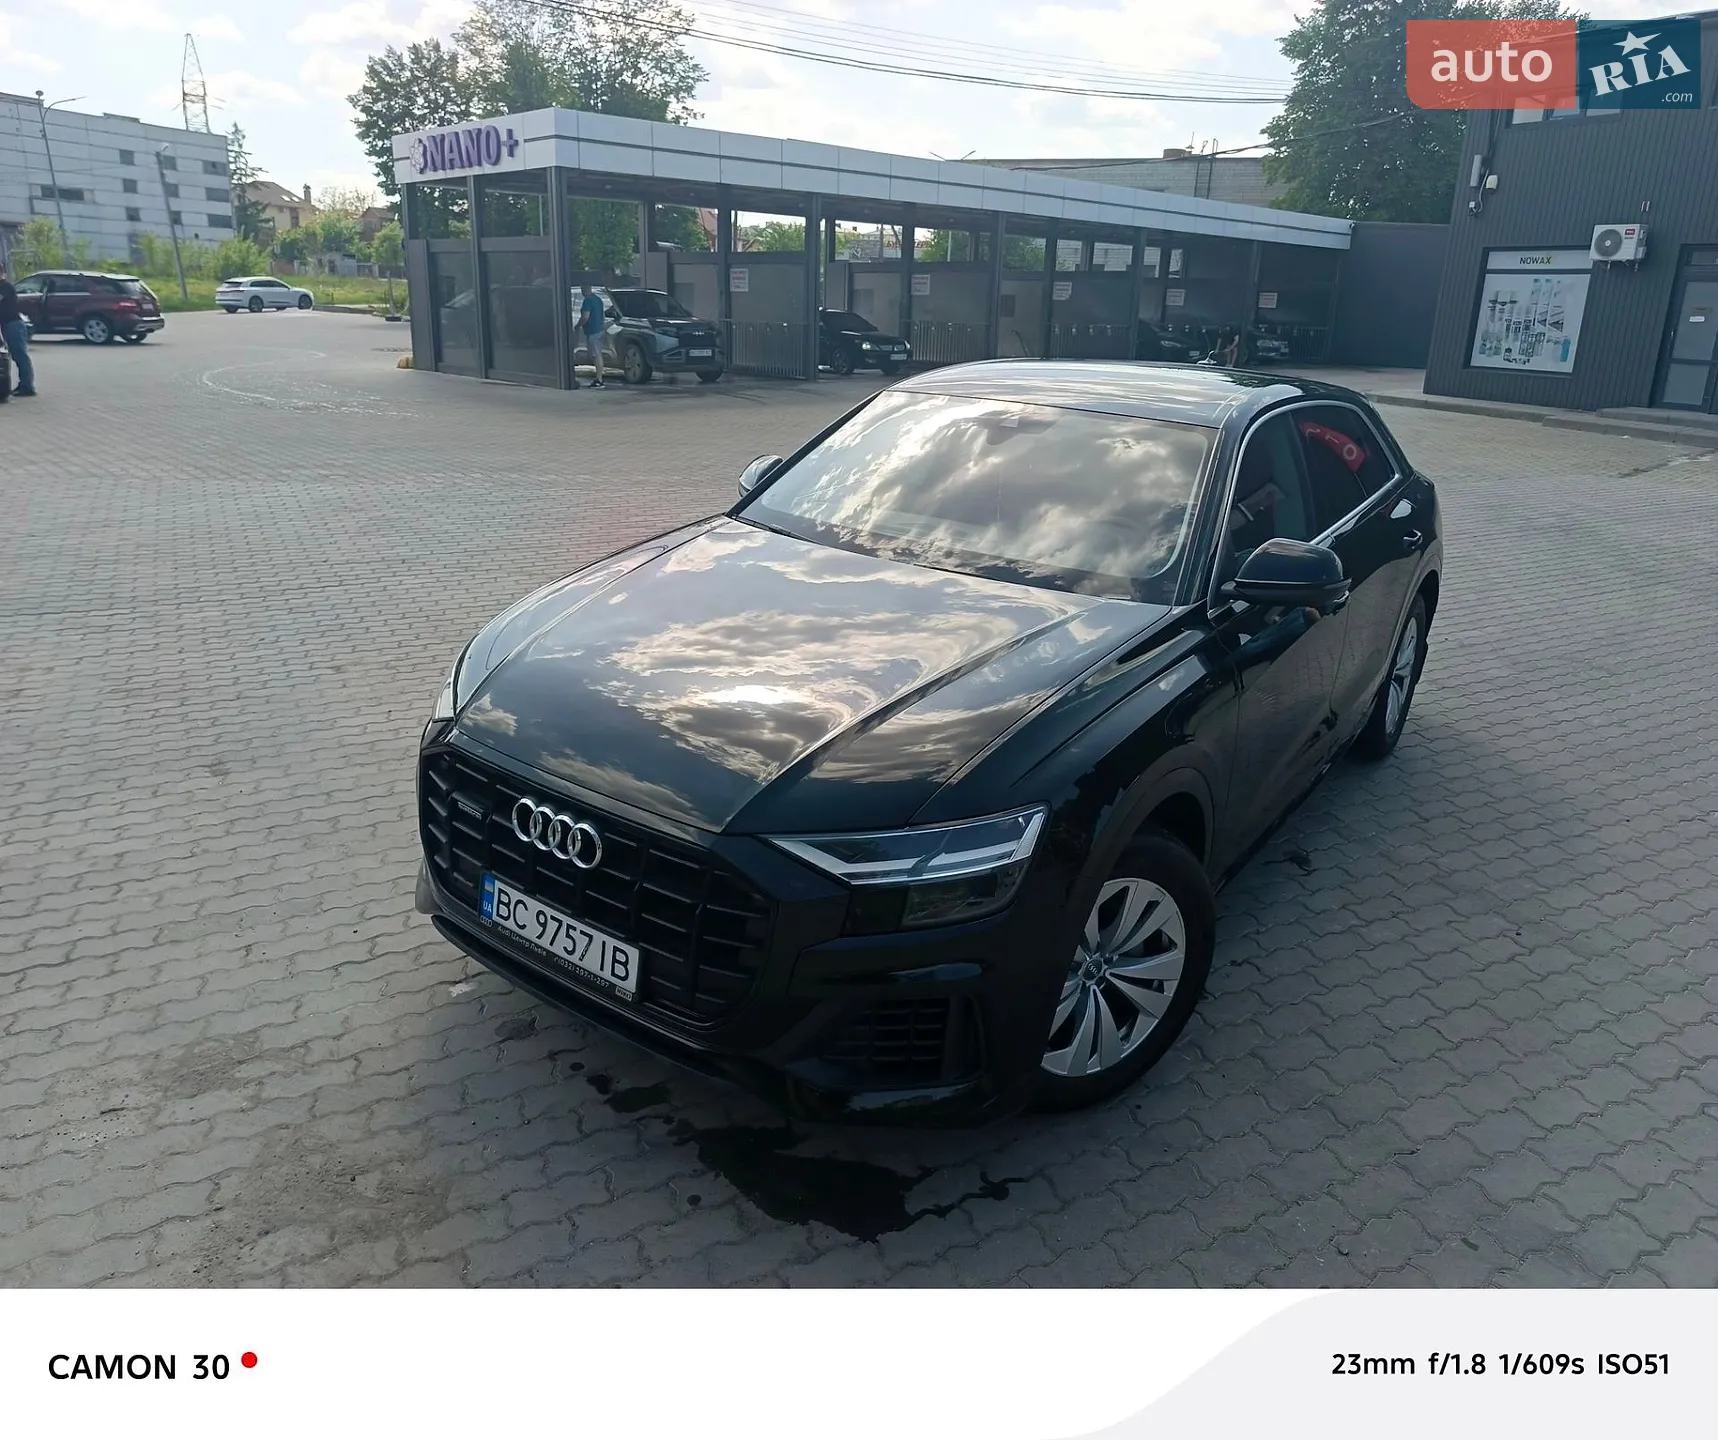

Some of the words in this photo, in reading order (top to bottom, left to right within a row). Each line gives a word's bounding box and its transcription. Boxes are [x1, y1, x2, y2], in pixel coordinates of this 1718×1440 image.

[1519, 256, 1552, 265] NOWAX
[483, 901, 492, 913] UA
[496, 887, 528, 930] BC
[535, 909, 593, 962] 9757
[600, 940, 630, 981] IB
